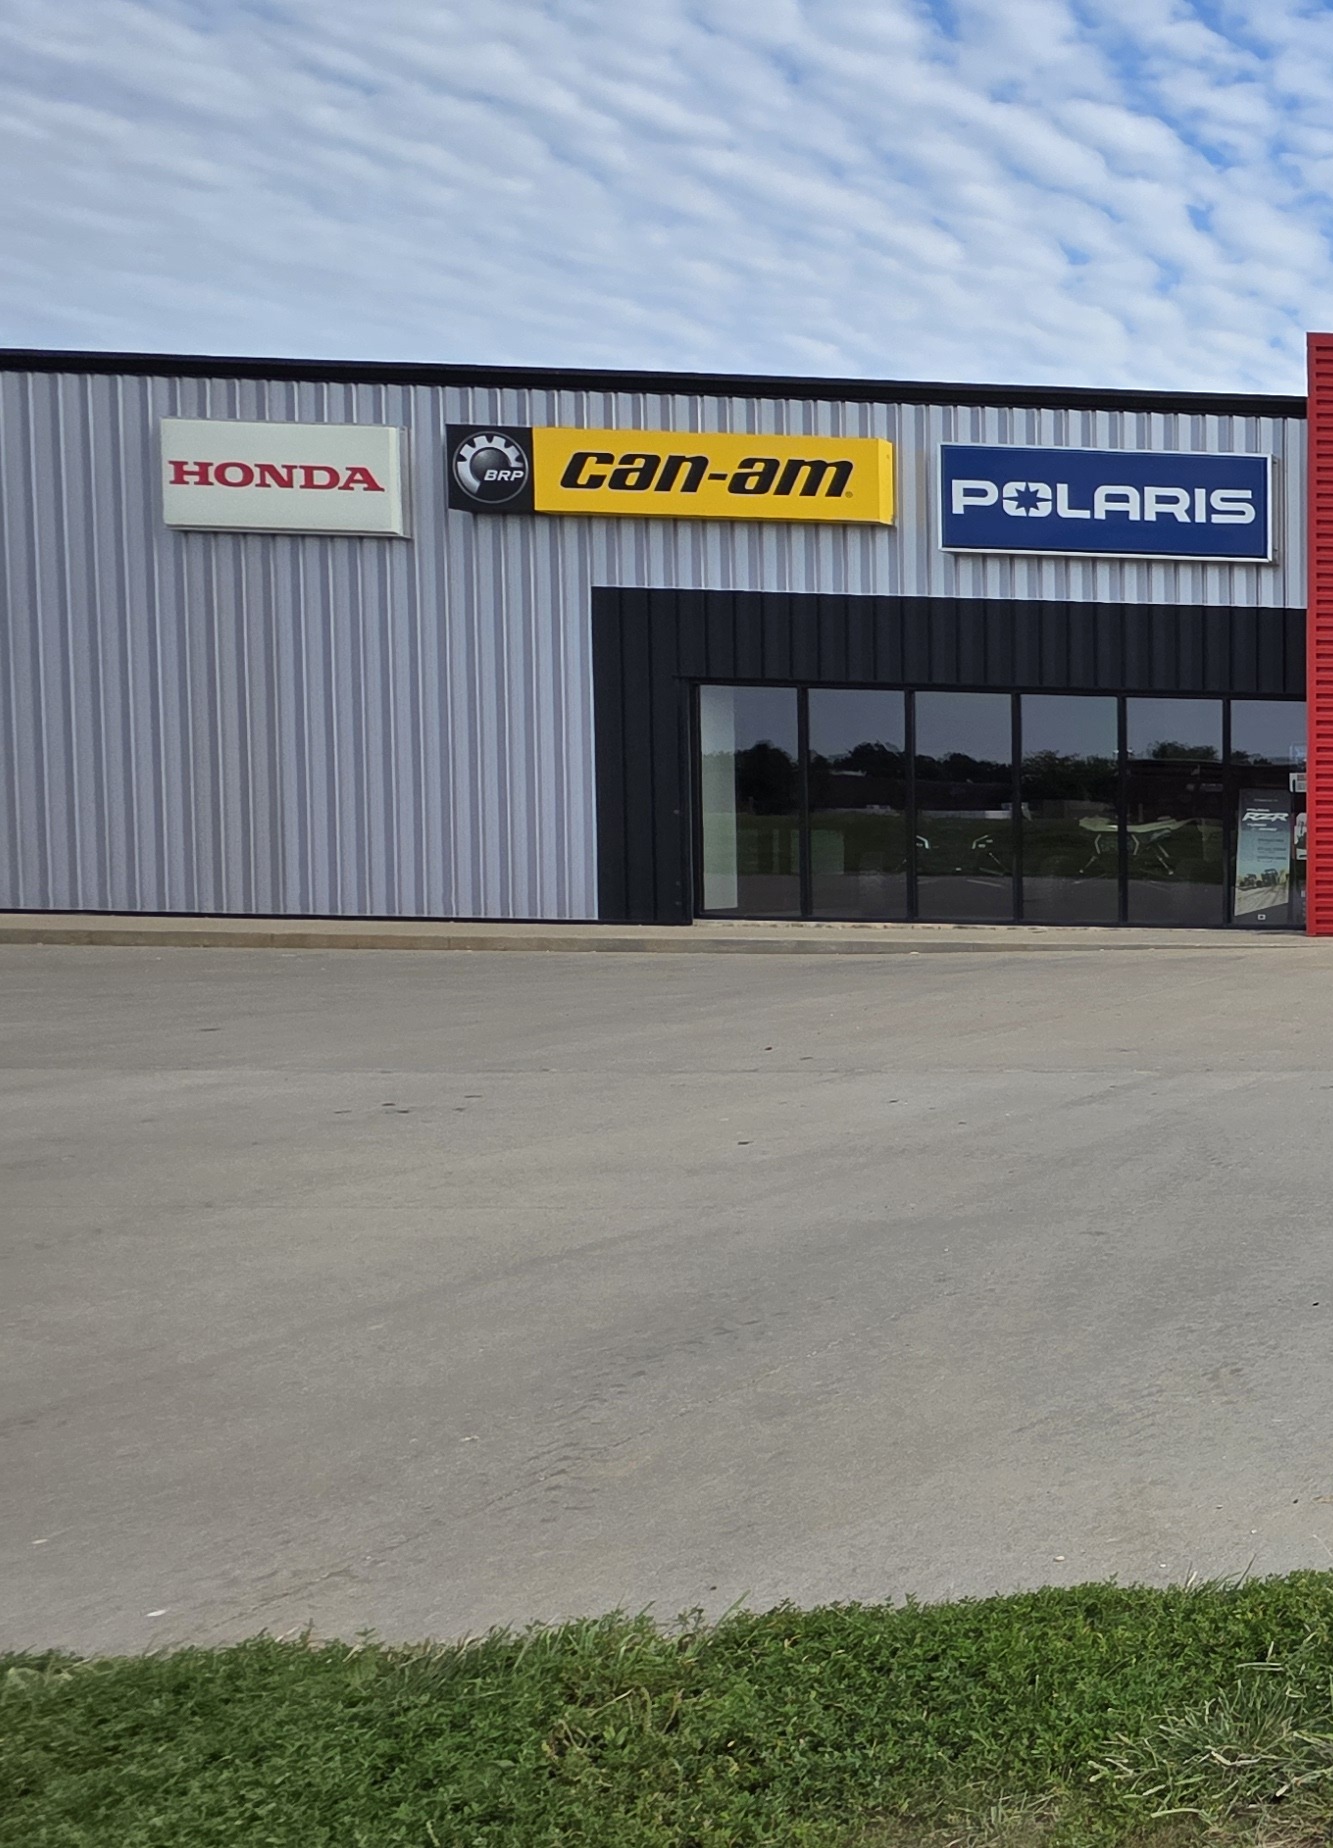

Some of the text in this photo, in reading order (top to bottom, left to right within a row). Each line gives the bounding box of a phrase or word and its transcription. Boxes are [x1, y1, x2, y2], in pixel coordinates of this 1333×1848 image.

[168, 460, 385, 492] HONDA
[483, 468, 524, 482] BRP
[560, 451, 854, 498] can-am
[952, 479, 1256, 524] POLARIS
